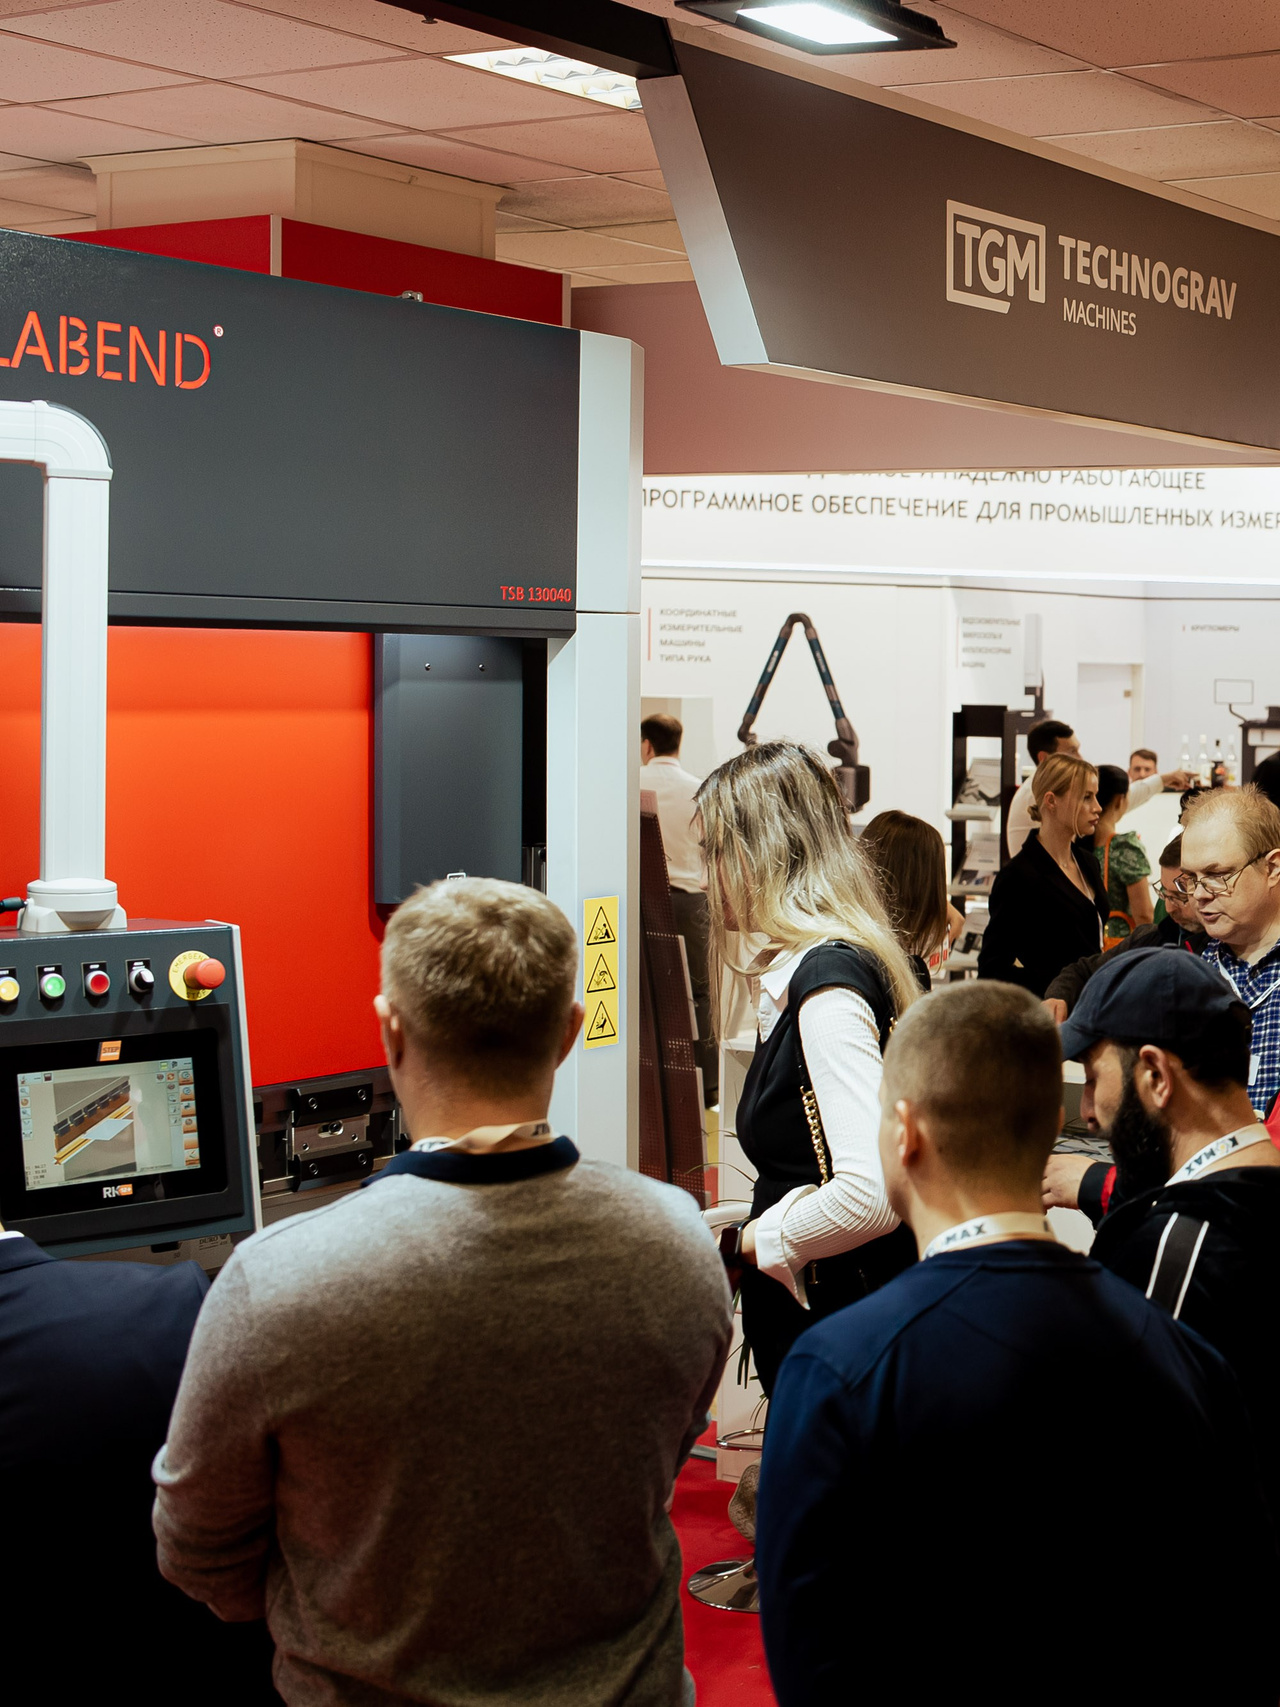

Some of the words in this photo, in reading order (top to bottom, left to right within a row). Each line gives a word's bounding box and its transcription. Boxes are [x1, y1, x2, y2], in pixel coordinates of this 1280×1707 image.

[956, 220, 1046, 304] TGM
[1058, 234, 1237, 320] TECHNOGRAV
[1063, 297, 1137, 336] MACHINES
[1060, 469, 1206, 492] РАБОТАЮЩЕЕ
[811, 494, 969, 519] ОБЕСПЕЧЕНИЕ
[976, 501, 1021, 524] ДЛЯ
[1030, 502, 1214, 528] ПРОМЫШЛЕННЫХ
[500, 586, 525, 601] TSB
[528, 587, 572, 603] 130040
[172, 952, 205, 974] EMERGEN
